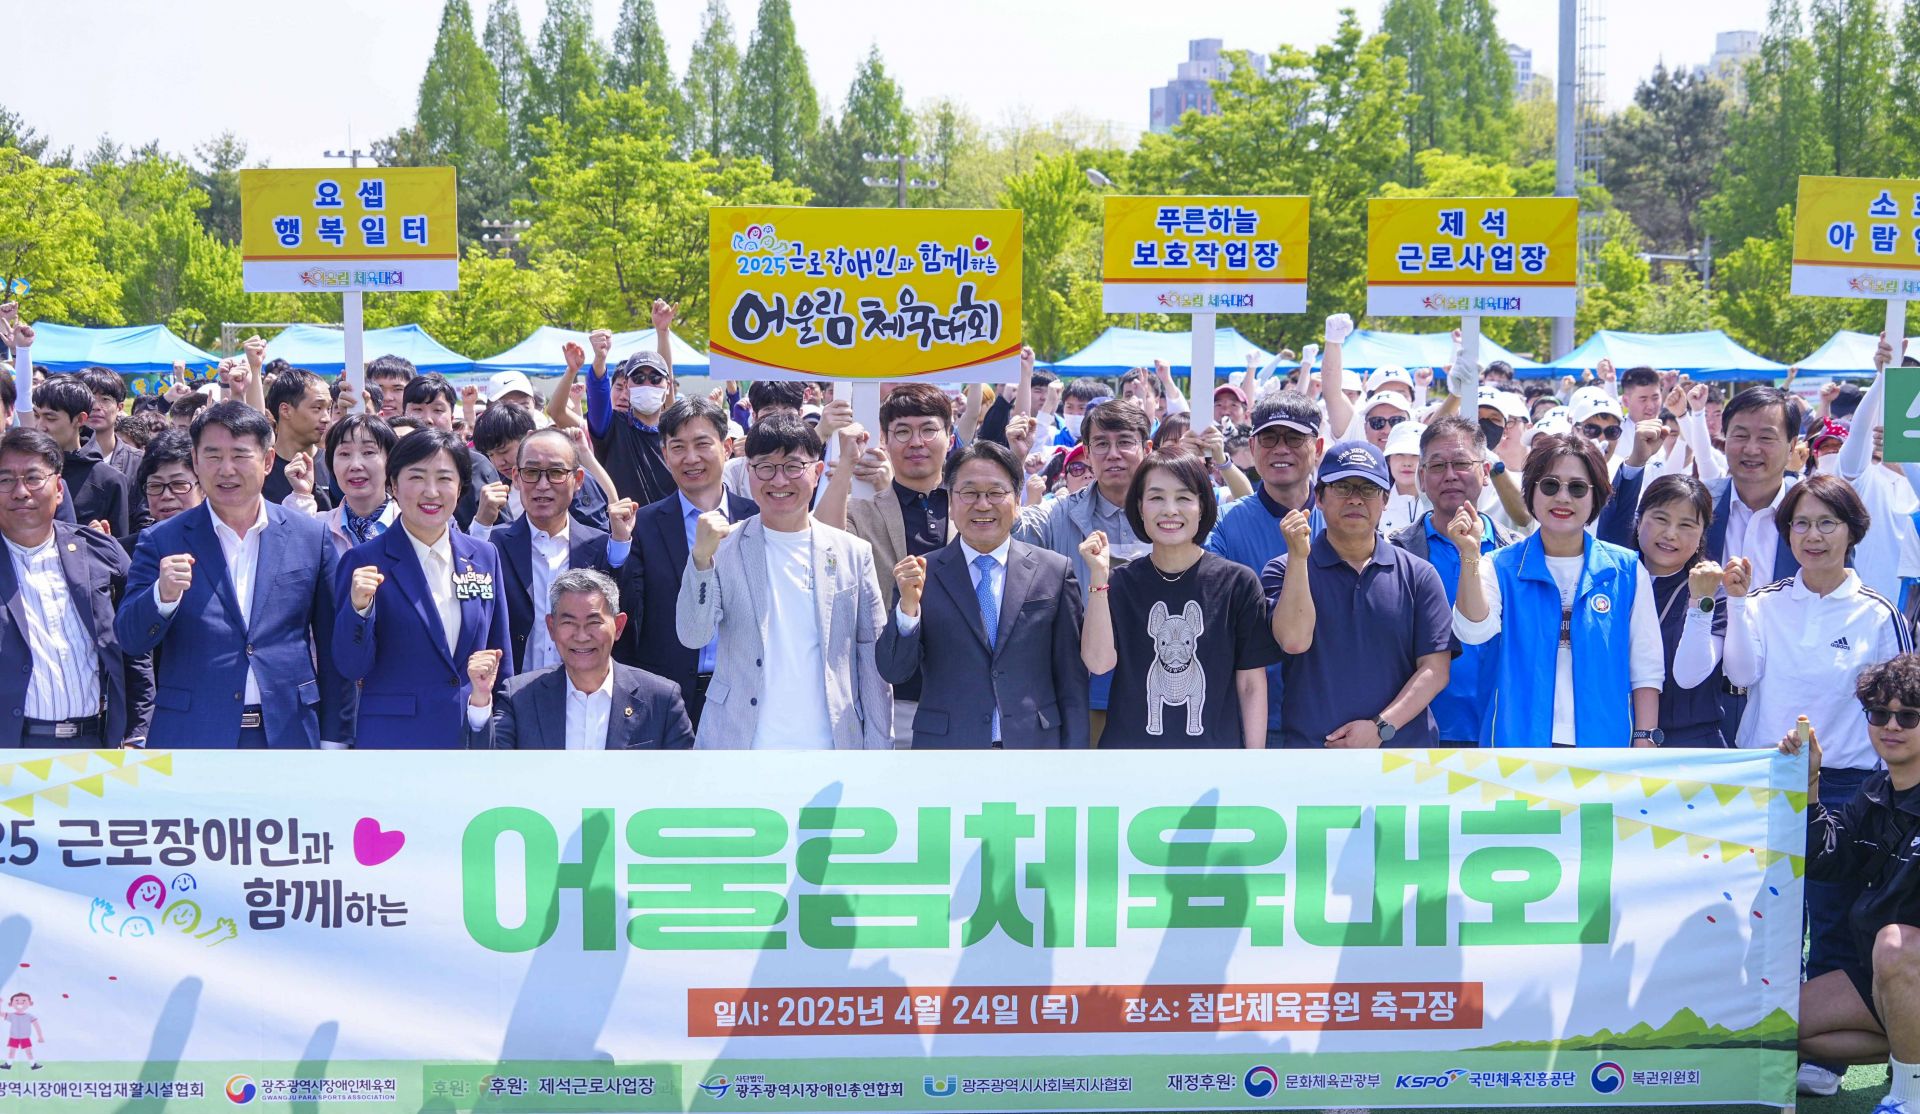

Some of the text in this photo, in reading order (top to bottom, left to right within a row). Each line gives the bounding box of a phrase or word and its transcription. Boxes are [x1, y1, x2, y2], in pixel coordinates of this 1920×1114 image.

[315, 181, 383, 209] 요셉
[1870, 192, 1920, 216] 소
[1157, 208, 1258, 234] 푸른하늘
[1440, 211, 1505, 237] 제석
[274, 217, 426, 247] 행복일터
[1829, 224, 1920, 253] 아람
[737, 242, 998, 279] 2025 근로장애인과 함께하는
[1133, 242, 1279, 268] 보호작업장
[1398, 245, 1546, 272] 근로사업장
[353, 270, 403, 286] 체육대회
[1208, 293, 1254, 308] 체육대회
[1473, 296, 1521, 311] 체육대회
[731, 284, 999, 348] 어울림 체육대회
[456, 582, 494, 599] 신수정
[1830, 642, 1850, 651] adidas
[0, 817, 334, 868] 5 근로장애인과
[461, 800, 1614, 954] 어울림체육대회
[243, 877, 409, 931] 함께하는
[713, 991, 1457, 1027] 일시: 2025년 4월 24일 (목) 장소: 첨단체육공원 축구장
[490, 1077, 528, 1095] 후원:
[538, 1077, 655, 1095] 제석근로사업장
[735, 1074, 764, 1083] 사단법인
[961, 1076, 1132, 1093] 광주광역시사회복지사협회
[1167, 1073, 1236, 1091] 재정후원:
[1285, 1074, 1381, 1089] 문화체육관광부
[1395, 1075, 1450, 1089] KSPO
[1468, 1071, 1576, 1087] 국민체육진흥공단
[1632, 1069, 1700, 1085] 복권위원회
[261, 1079, 396, 1094] 광주광역시장애인체육회
[735, 1082, 904, 1099] 광주광역시장애인총연합회
